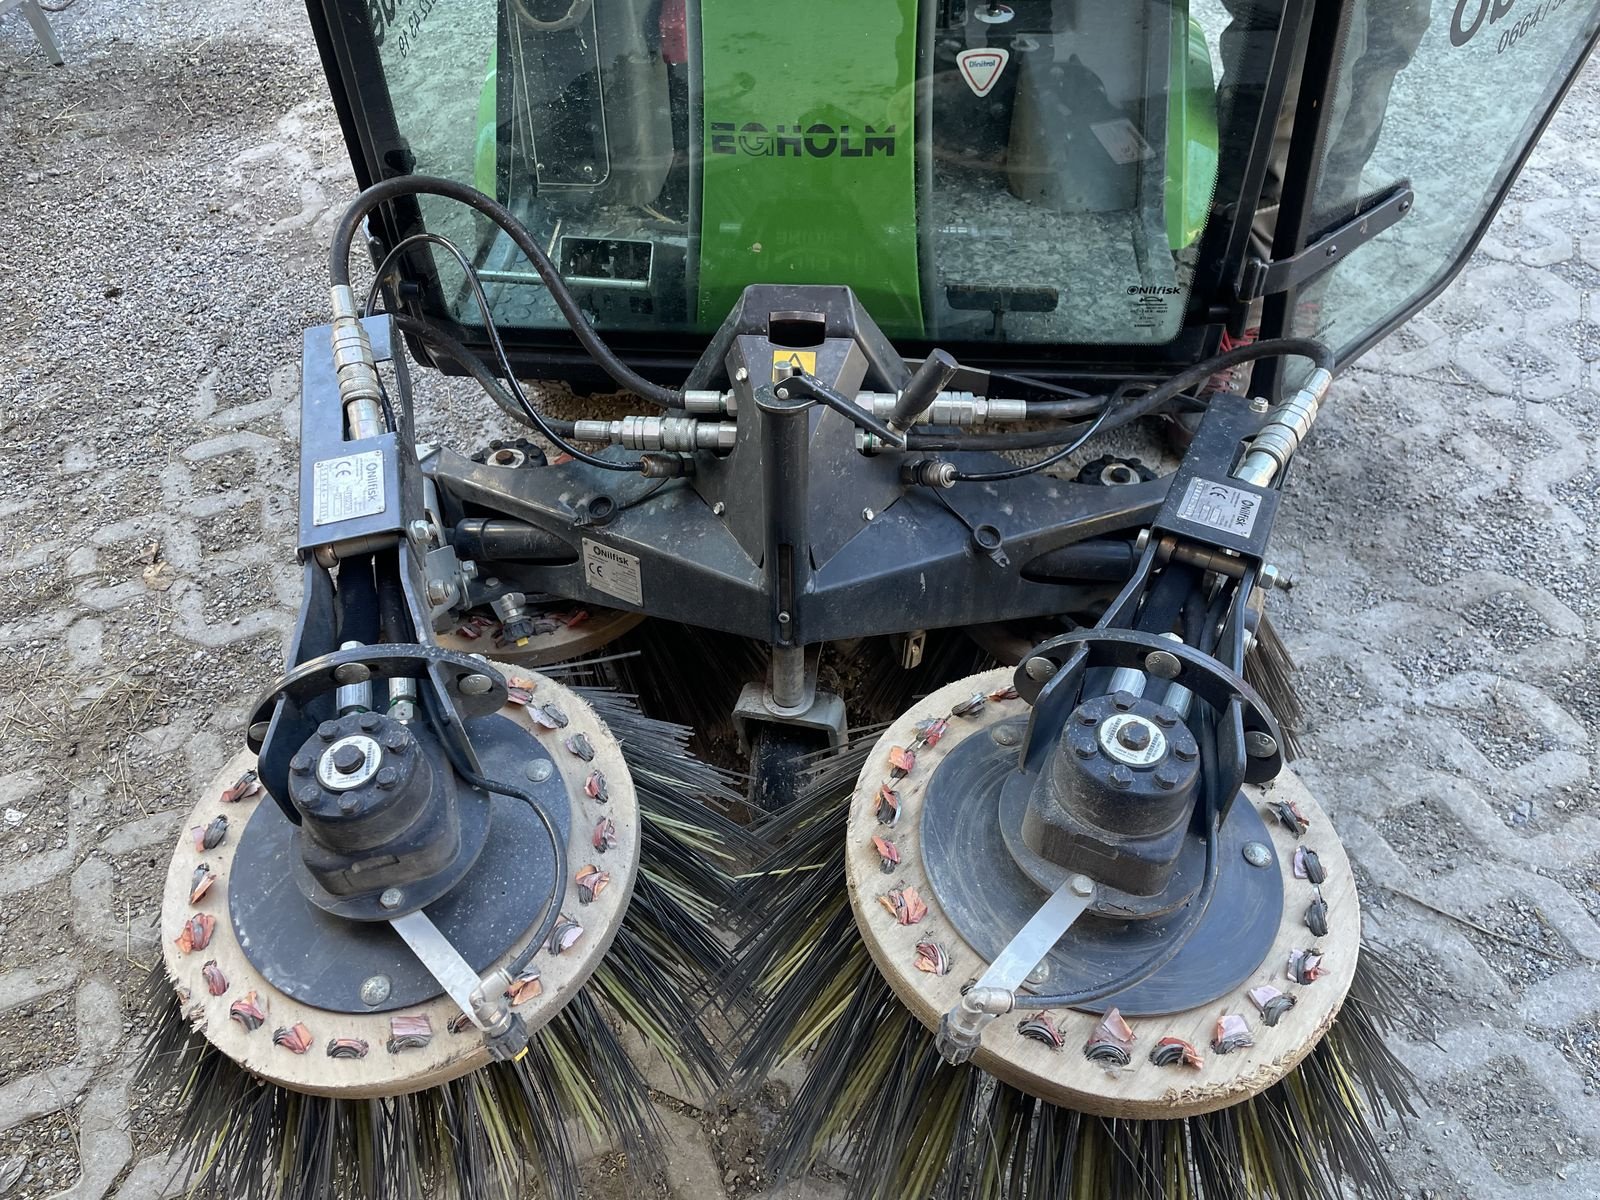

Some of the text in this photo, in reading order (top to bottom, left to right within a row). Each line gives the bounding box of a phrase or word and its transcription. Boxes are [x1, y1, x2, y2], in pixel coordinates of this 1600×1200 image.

[968, 59, 996, 68] Dinitrol
[710, 121, 896, 159] EGHOLM
[1138, 286, 1181, 295] Nilfisk
[366, 470, 379, 502] Nilfisk
[600, 548, 629, 567] Nilfisk
